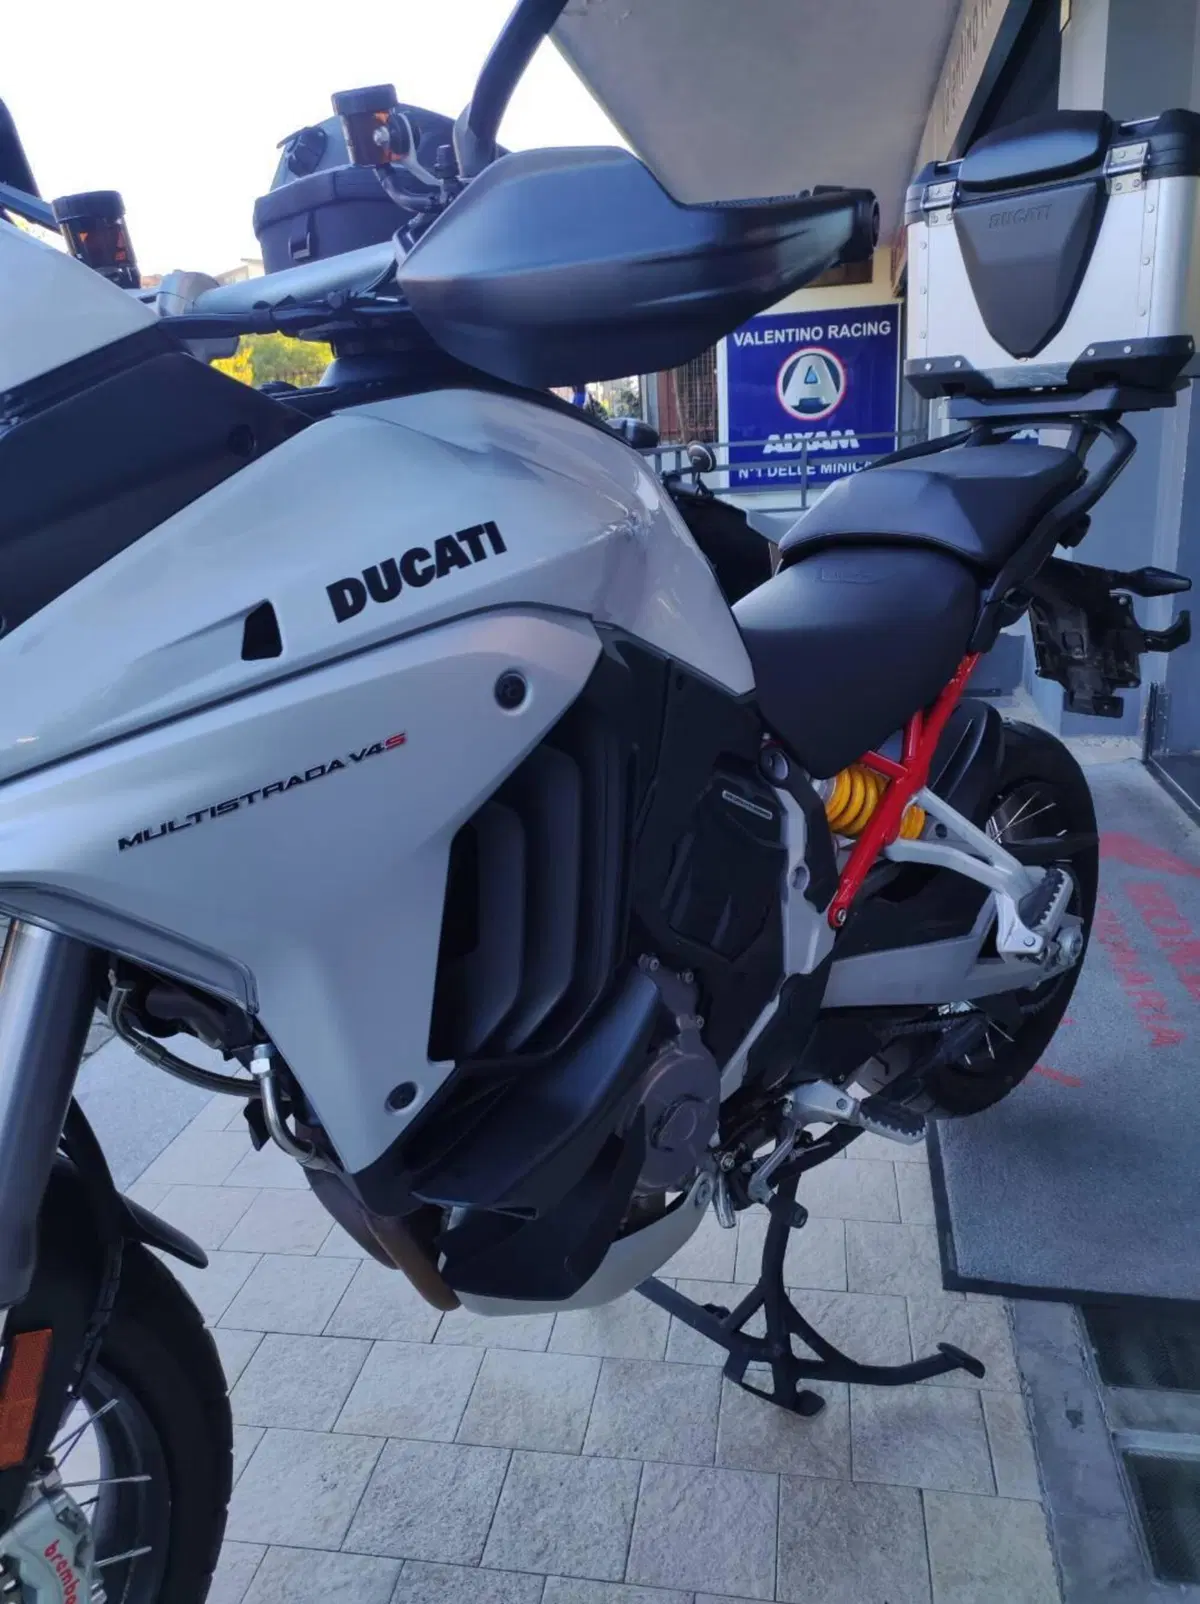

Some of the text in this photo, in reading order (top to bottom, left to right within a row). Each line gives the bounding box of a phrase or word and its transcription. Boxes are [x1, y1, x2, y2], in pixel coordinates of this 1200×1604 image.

[987, 203, 1053, 231] DUCATI
[733, 320, 891, 347] VALENTINO RACING
[325, 519, 508, 624] DUCATI
[117, 731, 407, 852] MULTISTRADA V4S
[43, 1538, 81, 1604] brembo
